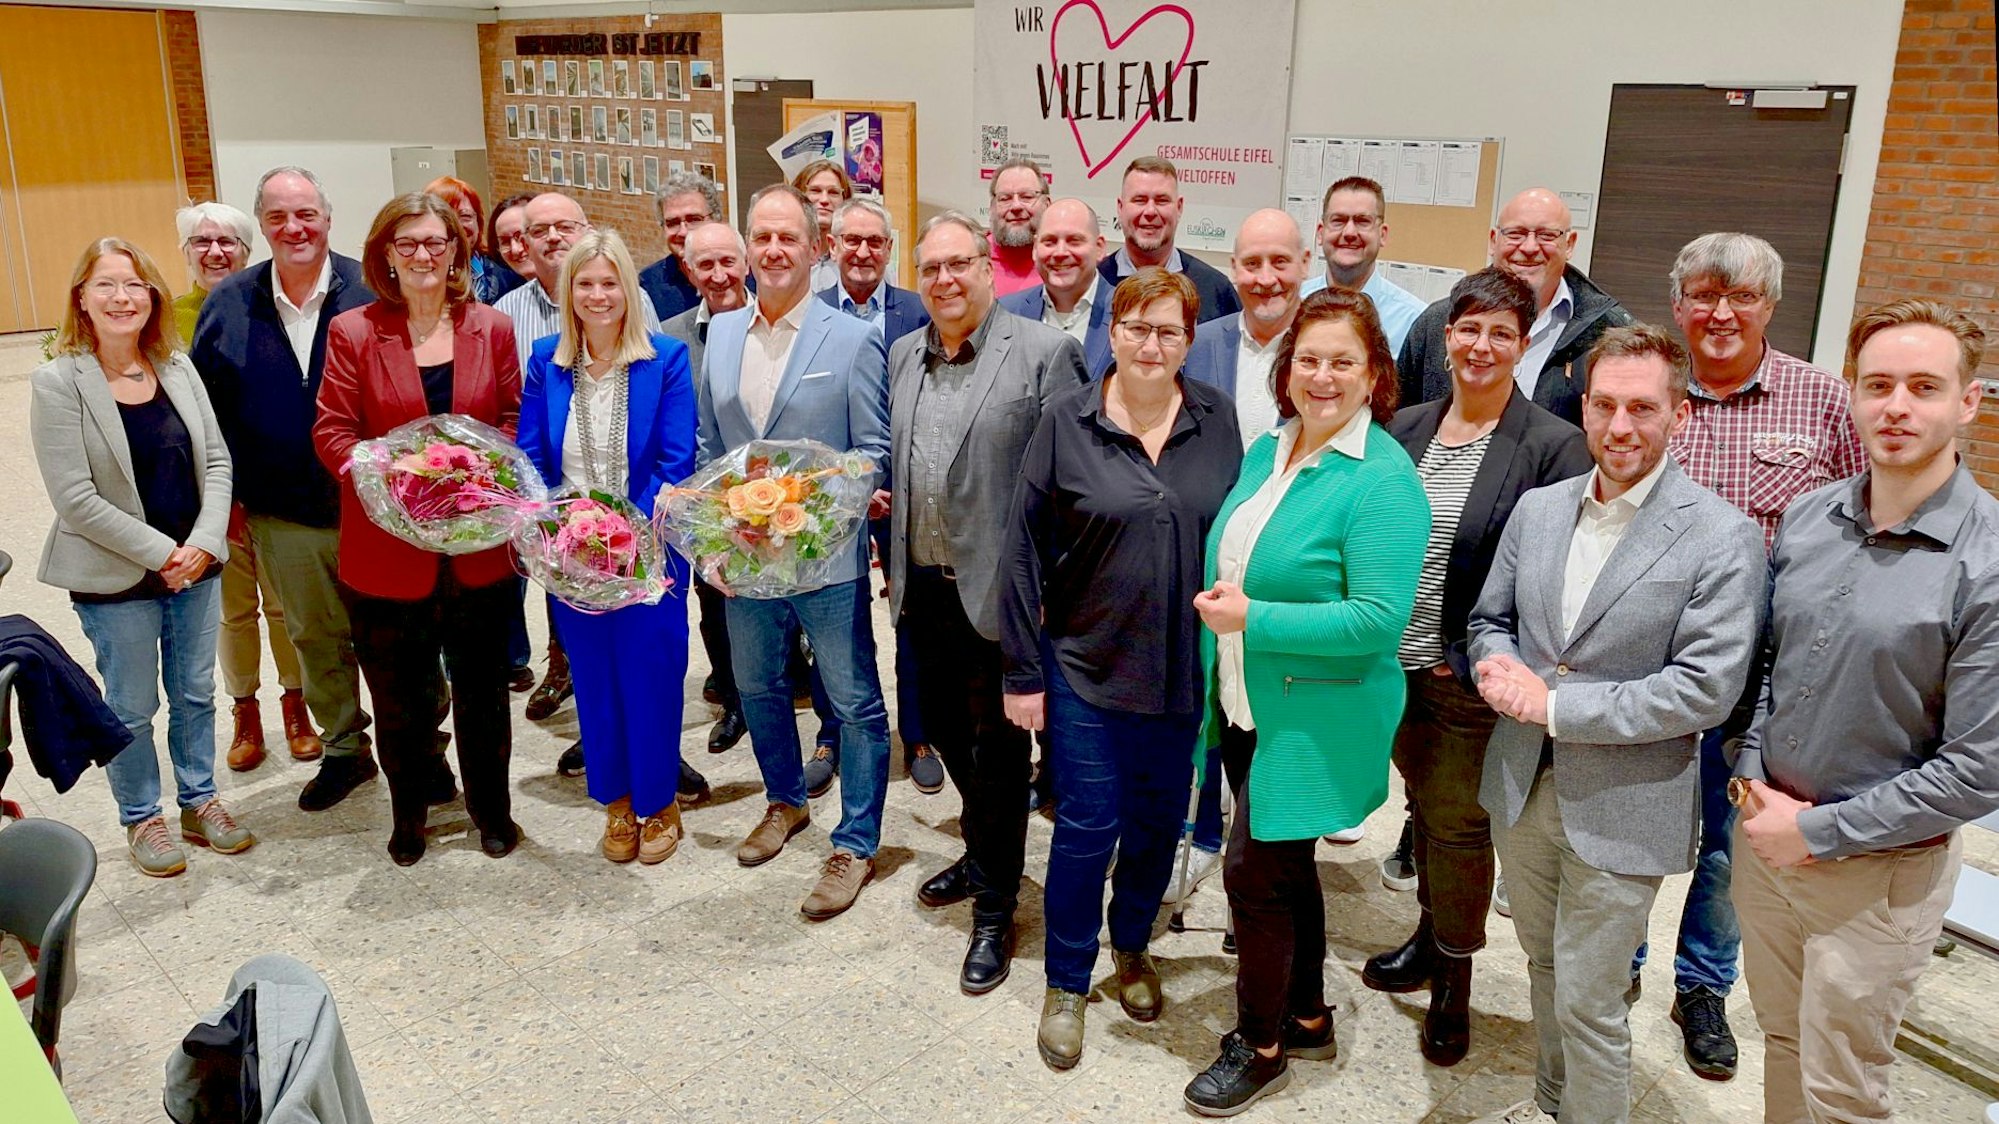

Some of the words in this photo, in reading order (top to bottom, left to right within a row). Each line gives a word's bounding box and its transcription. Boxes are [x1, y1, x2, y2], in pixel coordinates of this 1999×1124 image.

[1015, 6, 1044, 33] WIR
[1036, 60, 1210, 122] VIELFALT
[1157, 145, 1240, 162] GESAMTSCHULE
[1243, 148, 1274, 163] EIFEL
